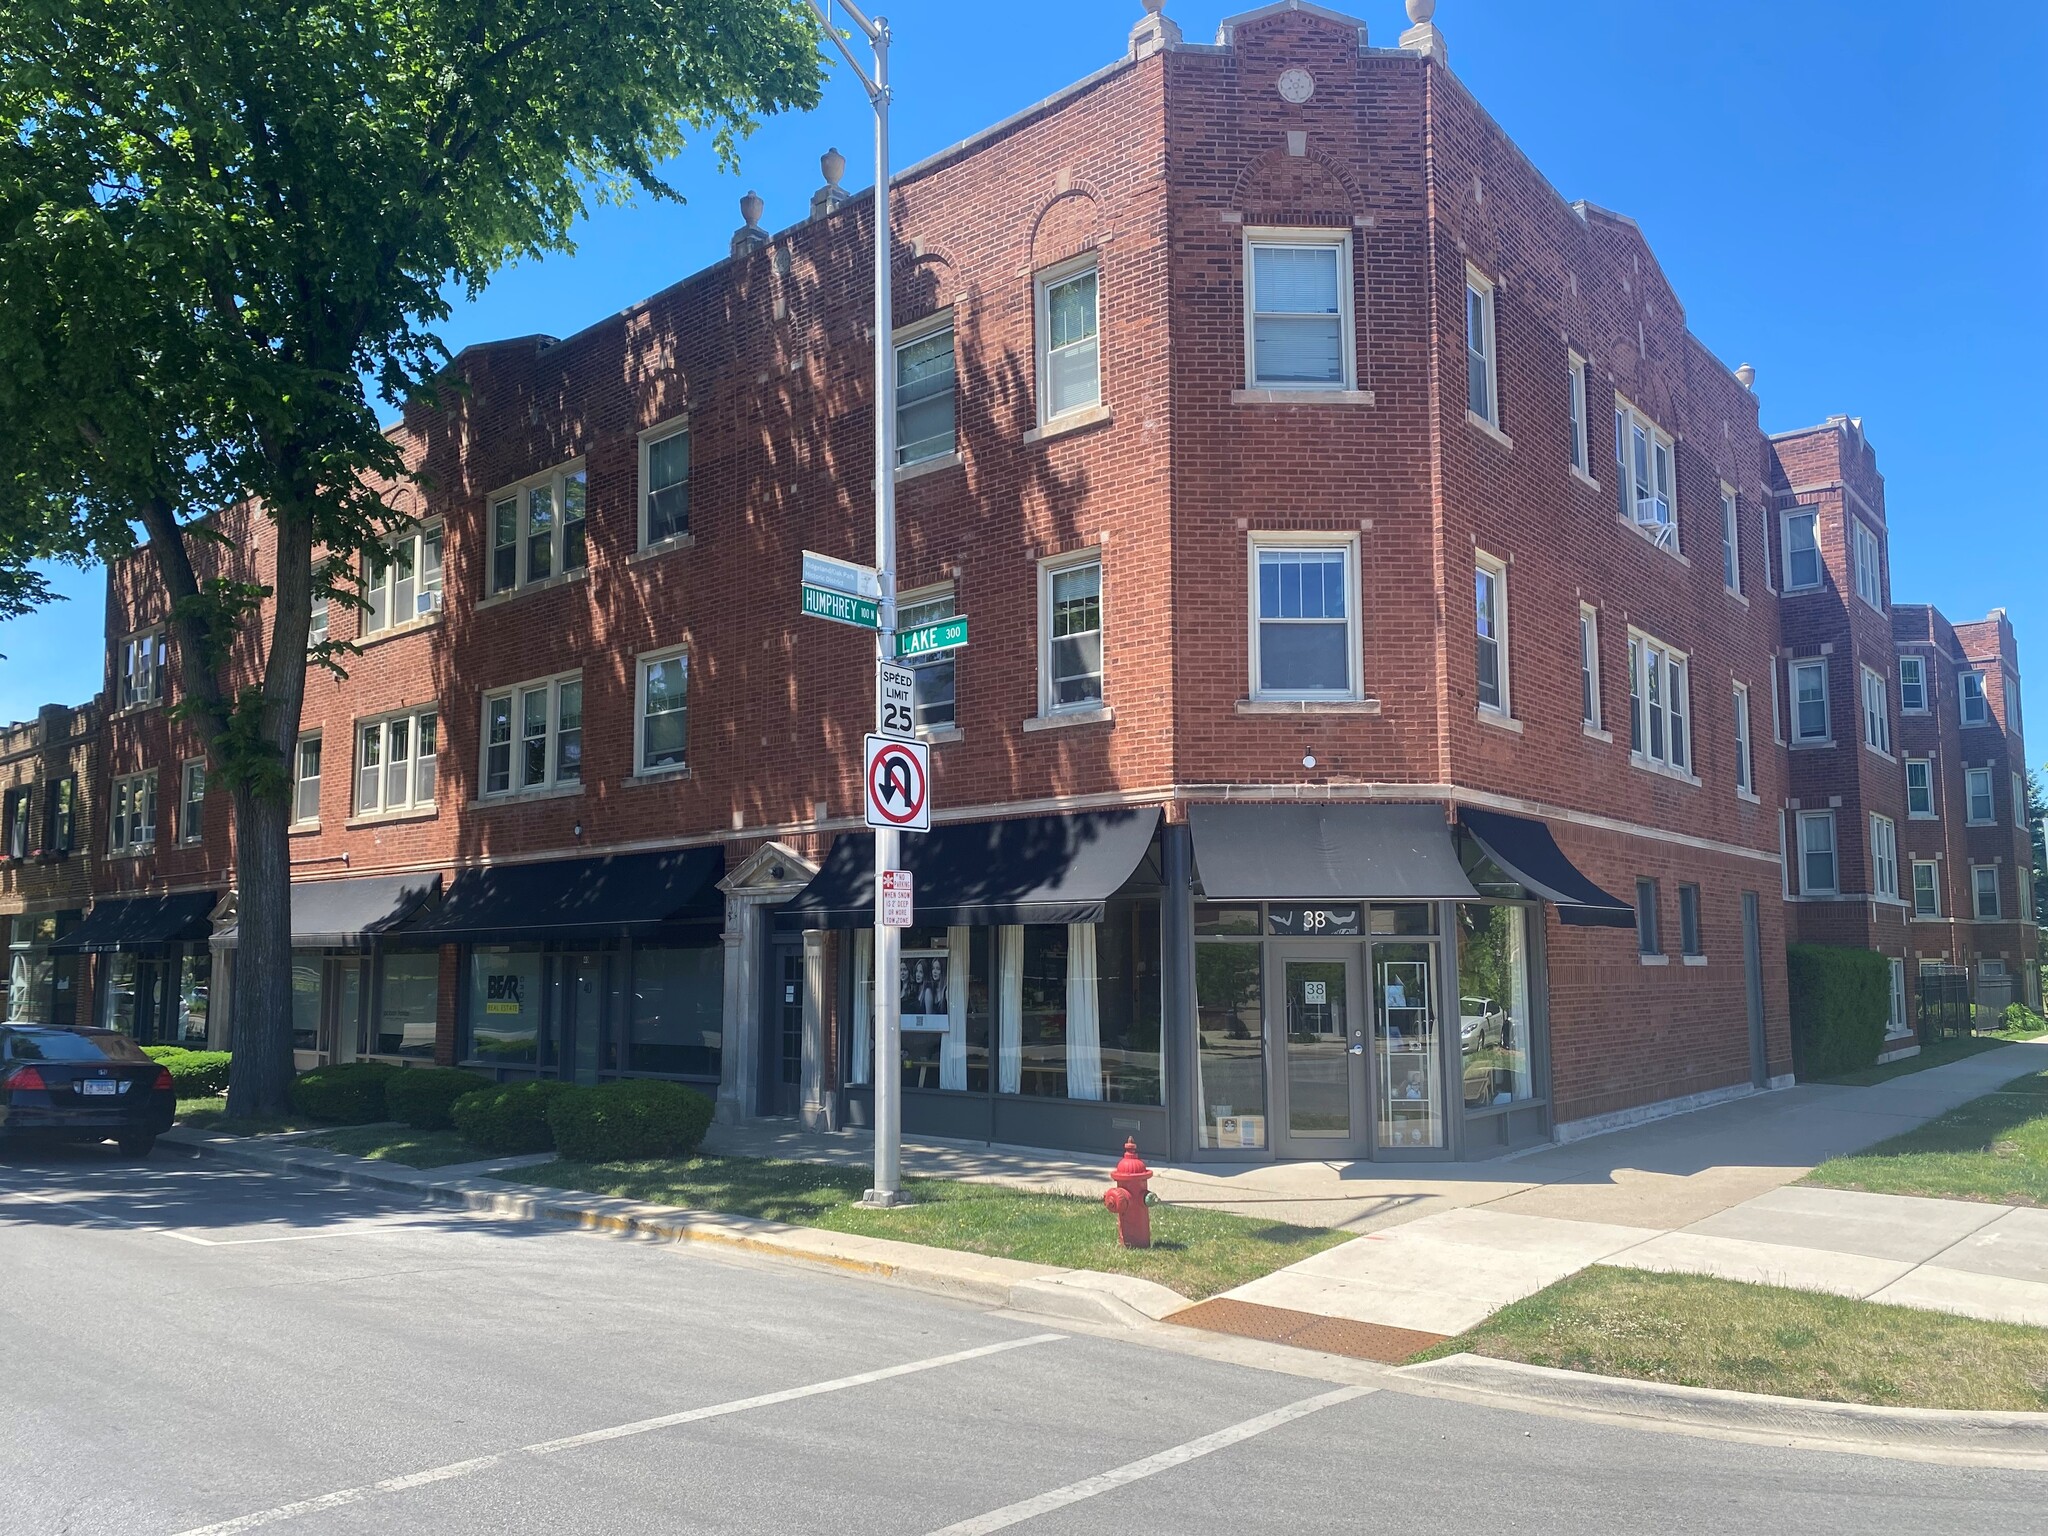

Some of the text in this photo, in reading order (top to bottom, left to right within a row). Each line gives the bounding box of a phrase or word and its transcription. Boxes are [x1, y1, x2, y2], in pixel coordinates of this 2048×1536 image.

[805, 570, 826, 580] Historic
[806, 589, 857, 620] HUMPHREY
[861, 607, 870, 619] 100
[902, 626, 961, 654] LAKE 300
[883, 671, 912, 687] SPEED
[886, 687, 909, 701] LIMIT
[884, 703, 912, 732] 25
[894, 881, 910, 889] PARKING
[897, 891, 910, 899] SNOW
[1303, 910, 1326, 928] 38
[1306, 983, 1325, 995] 38
